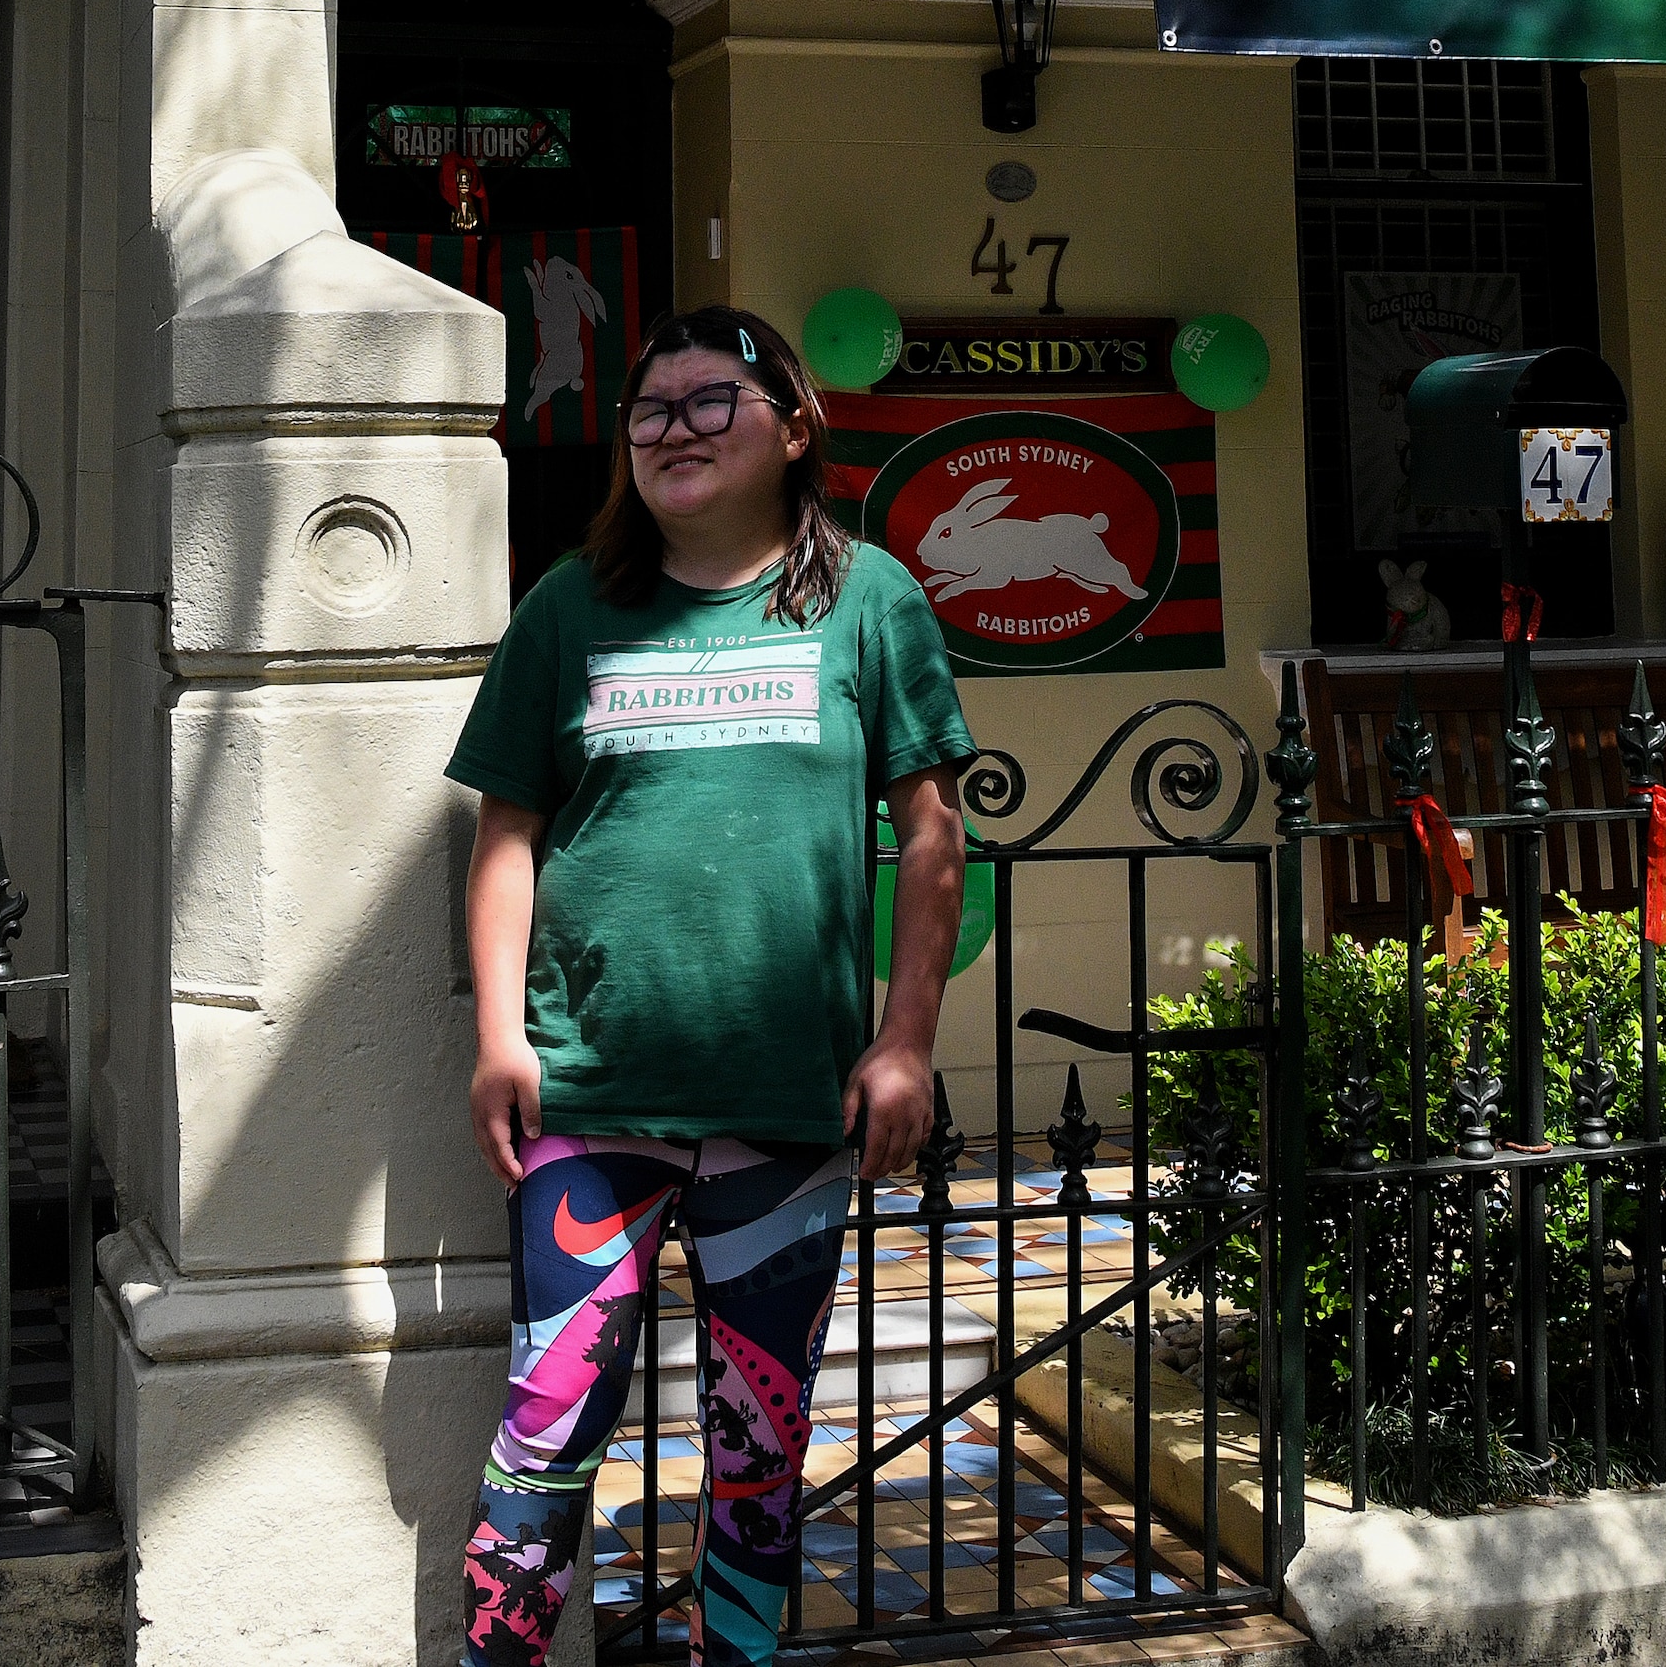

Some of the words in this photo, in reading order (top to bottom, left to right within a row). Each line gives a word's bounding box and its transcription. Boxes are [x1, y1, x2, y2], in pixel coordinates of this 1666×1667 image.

[393, 124, 531, 159] RABBITOHS
[970, 214, 1071, 316] 47
[1367, 290, 1435, 324] RAGING
[1401, 307, 1503, 345] RABBITOHS
[897, 339, 1148, 375] CASSIDY'S
[1189, 329, 1220, 365] TRY!
[945, 445, 1012, 477] SOUTH
[1018, 444, 1095, 474] SYDNEY
[1530, 445, 1604, 505] 47
[976, 606, 1092, 636] RABBITOHS
[667, 637, 697, 649] EST
[706, 634, 748, 649] 1908
[607, 679, 795, 713] RABBITOHS
[588, 731, 674, 753] SOUTH
[699, 723, 810, 742] SYDNEY
